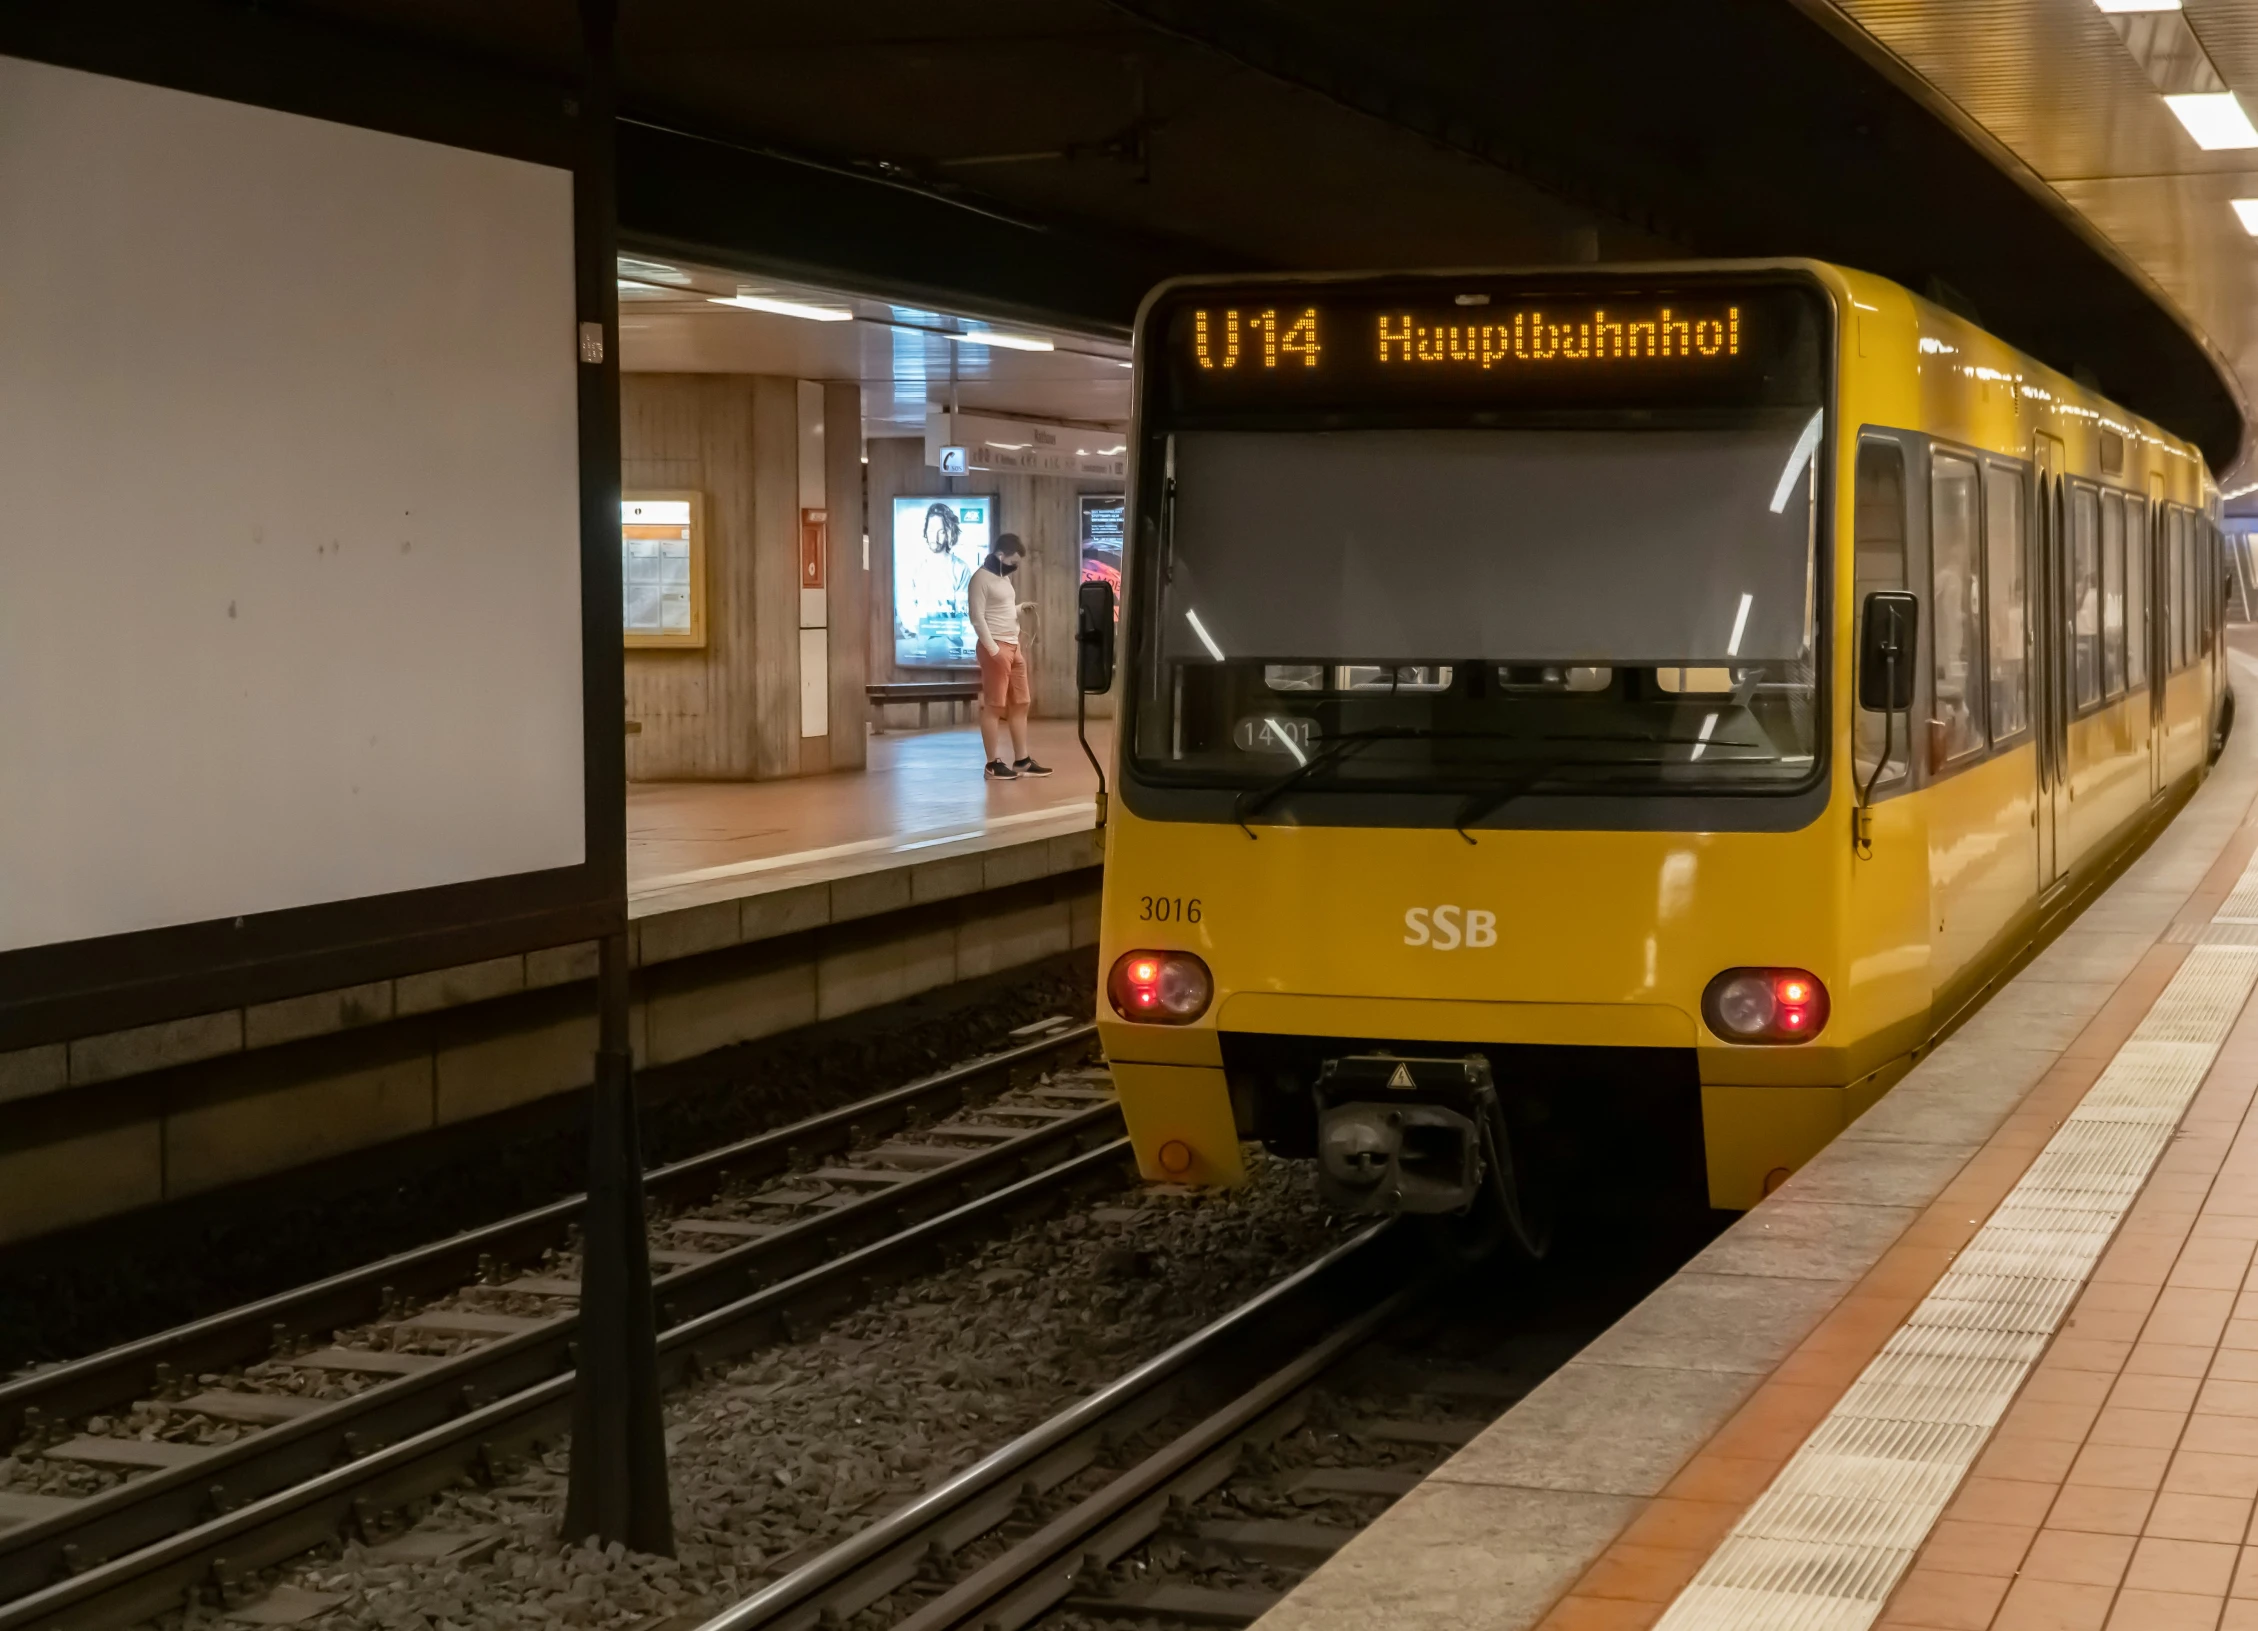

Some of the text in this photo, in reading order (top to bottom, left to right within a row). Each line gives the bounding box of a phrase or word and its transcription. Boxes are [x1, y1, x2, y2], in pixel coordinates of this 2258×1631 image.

[1196, 309, 1321, 368] U14
[1139, 896, 1202, 924] 3016
[1404, 904, 1498, 951] SSB
